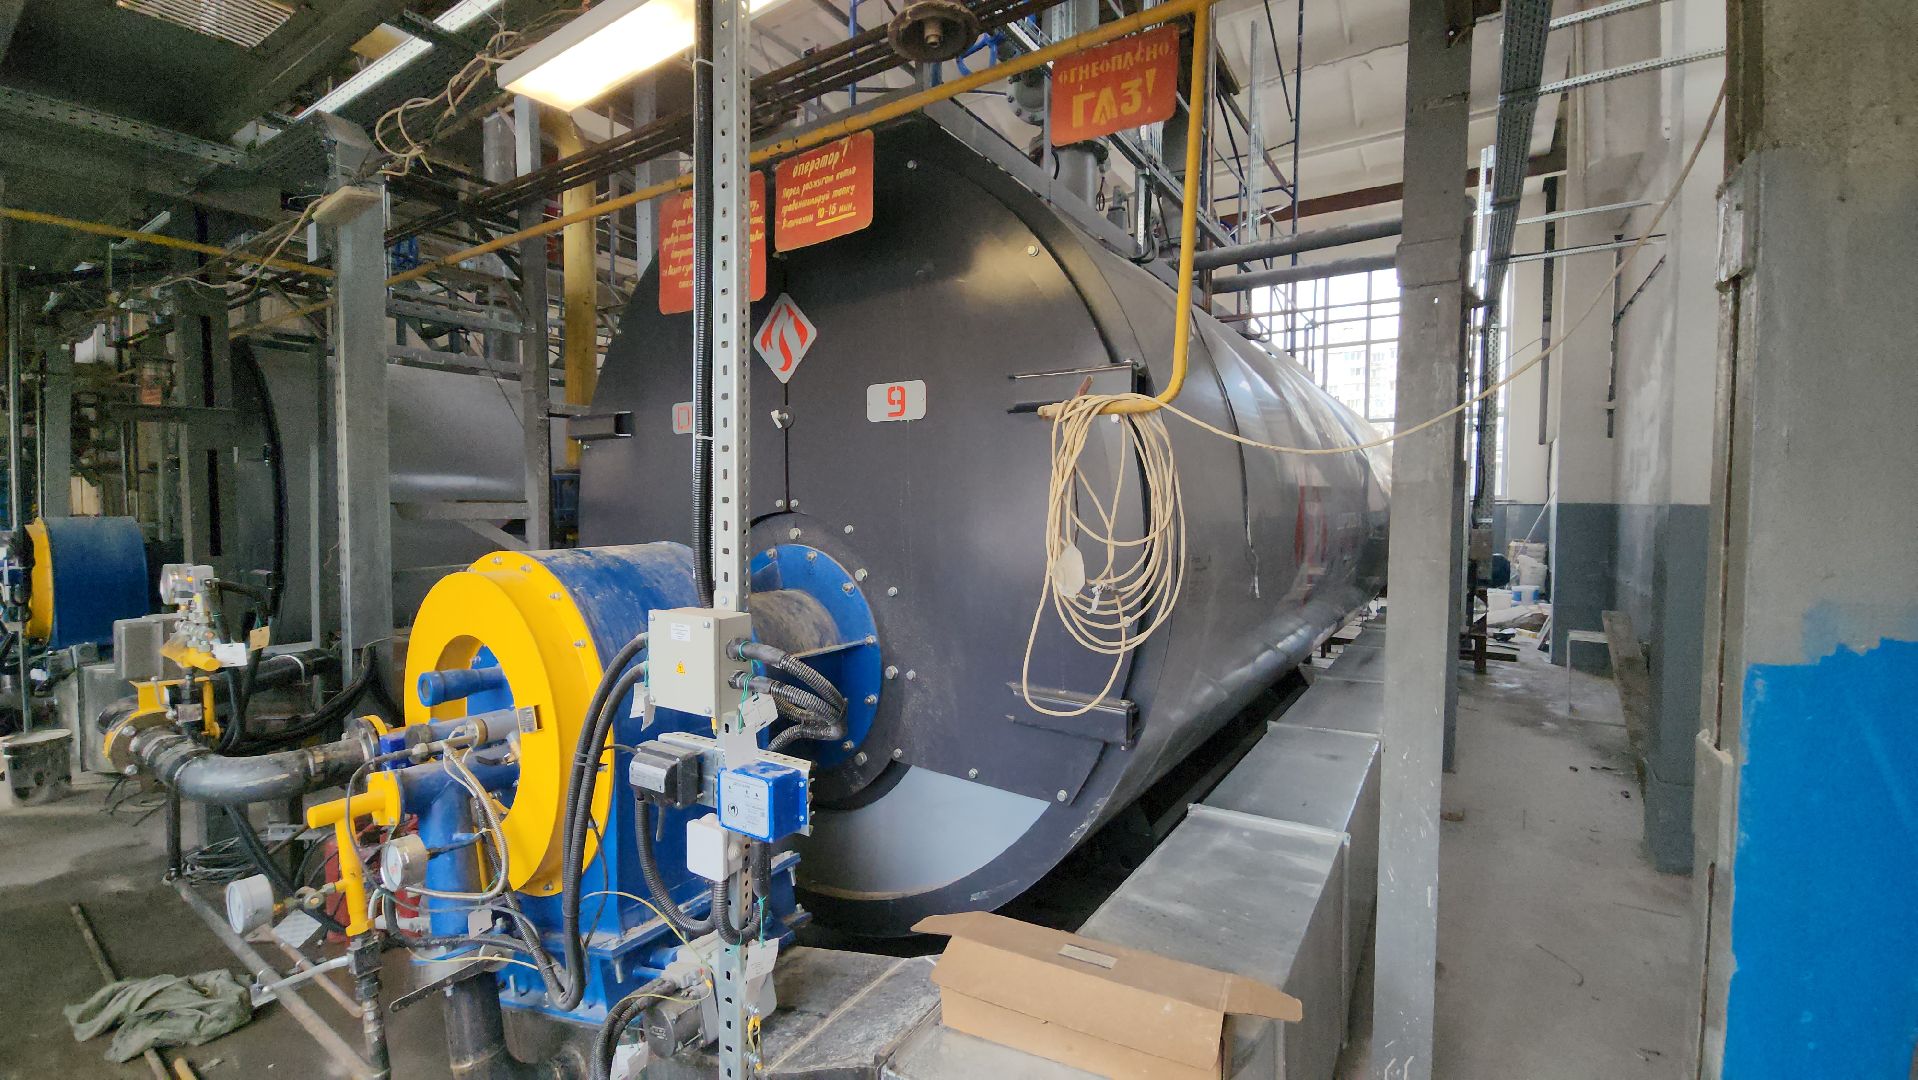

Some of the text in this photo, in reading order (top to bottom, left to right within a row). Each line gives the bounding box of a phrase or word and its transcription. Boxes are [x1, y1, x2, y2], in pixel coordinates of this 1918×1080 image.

[1072, 67, 1157, 128] ГАЗ!
[817, 202, 837, 219] 10-15
[887, 385, 906, 417] 9
